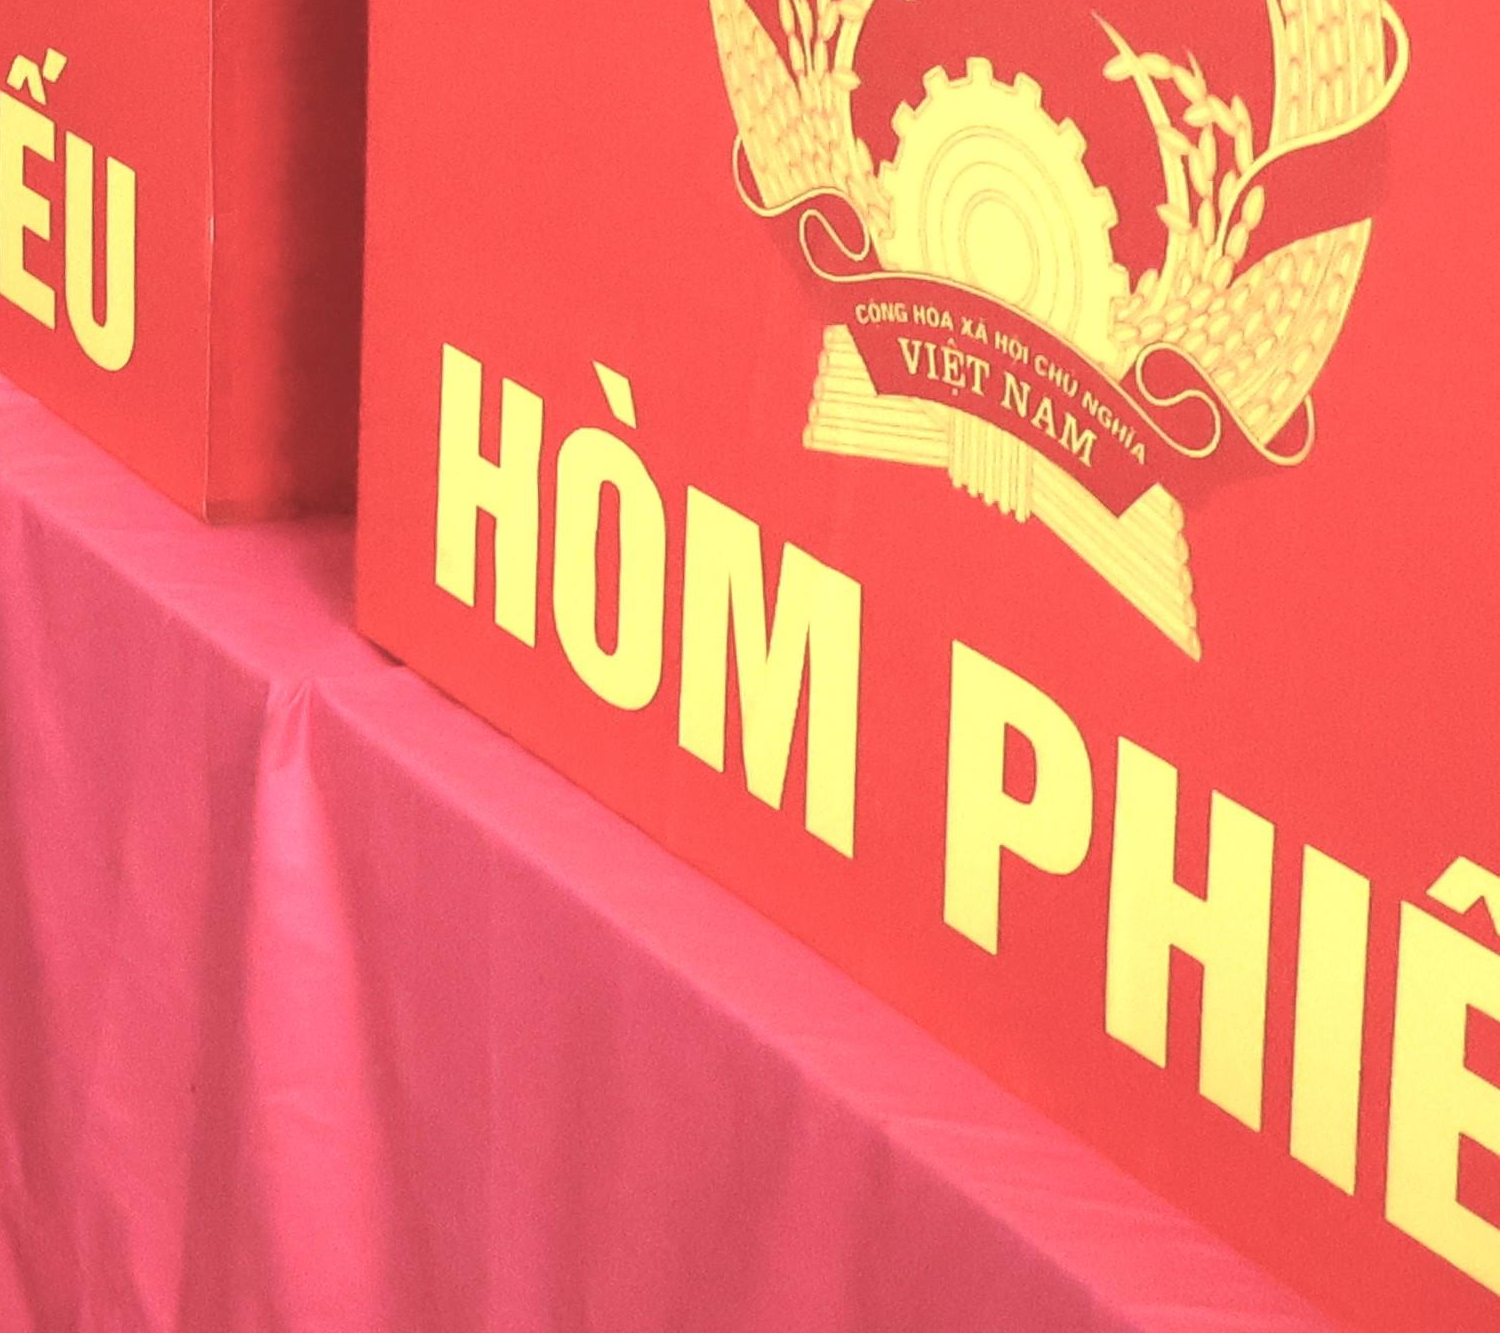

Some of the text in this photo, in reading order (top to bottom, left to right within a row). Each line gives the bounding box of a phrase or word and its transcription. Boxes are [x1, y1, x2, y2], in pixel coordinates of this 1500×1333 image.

[897, 337, 1098, 467] VIỆT NAM
[435, 342, 863, 860] HÒM
